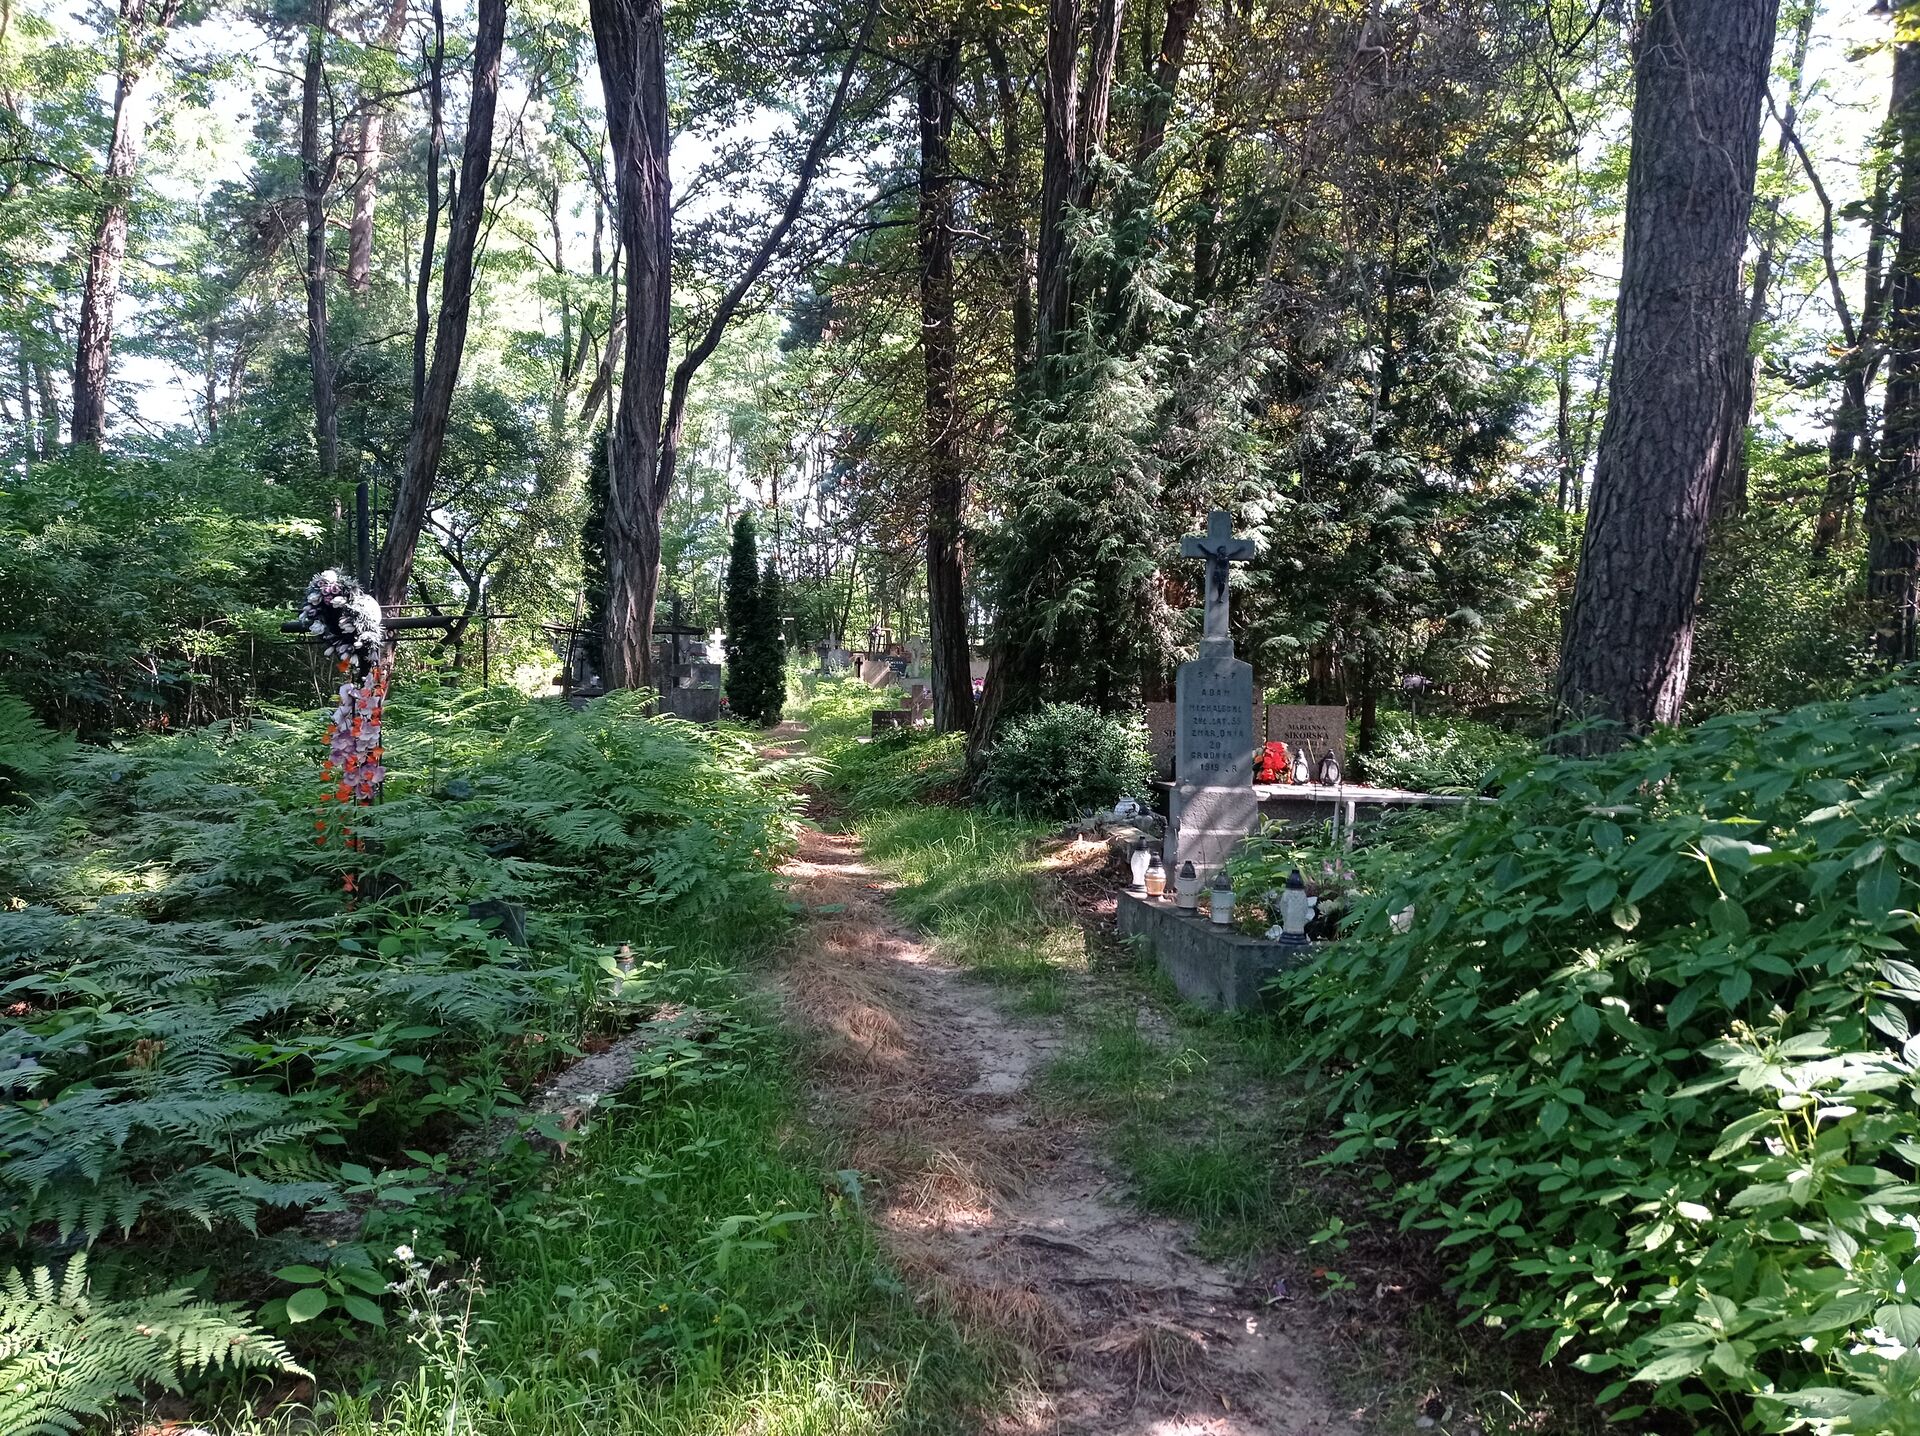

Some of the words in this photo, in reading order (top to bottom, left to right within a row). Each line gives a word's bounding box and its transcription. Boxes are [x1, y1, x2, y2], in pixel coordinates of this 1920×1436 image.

[1201, 688, 1230, 697] ADAM
[1288, 723, 1327, 731] MARIANNA
[1284, 731, 1329, 740] SIKORSKA
[1209, 740, 1221, 749] 20
